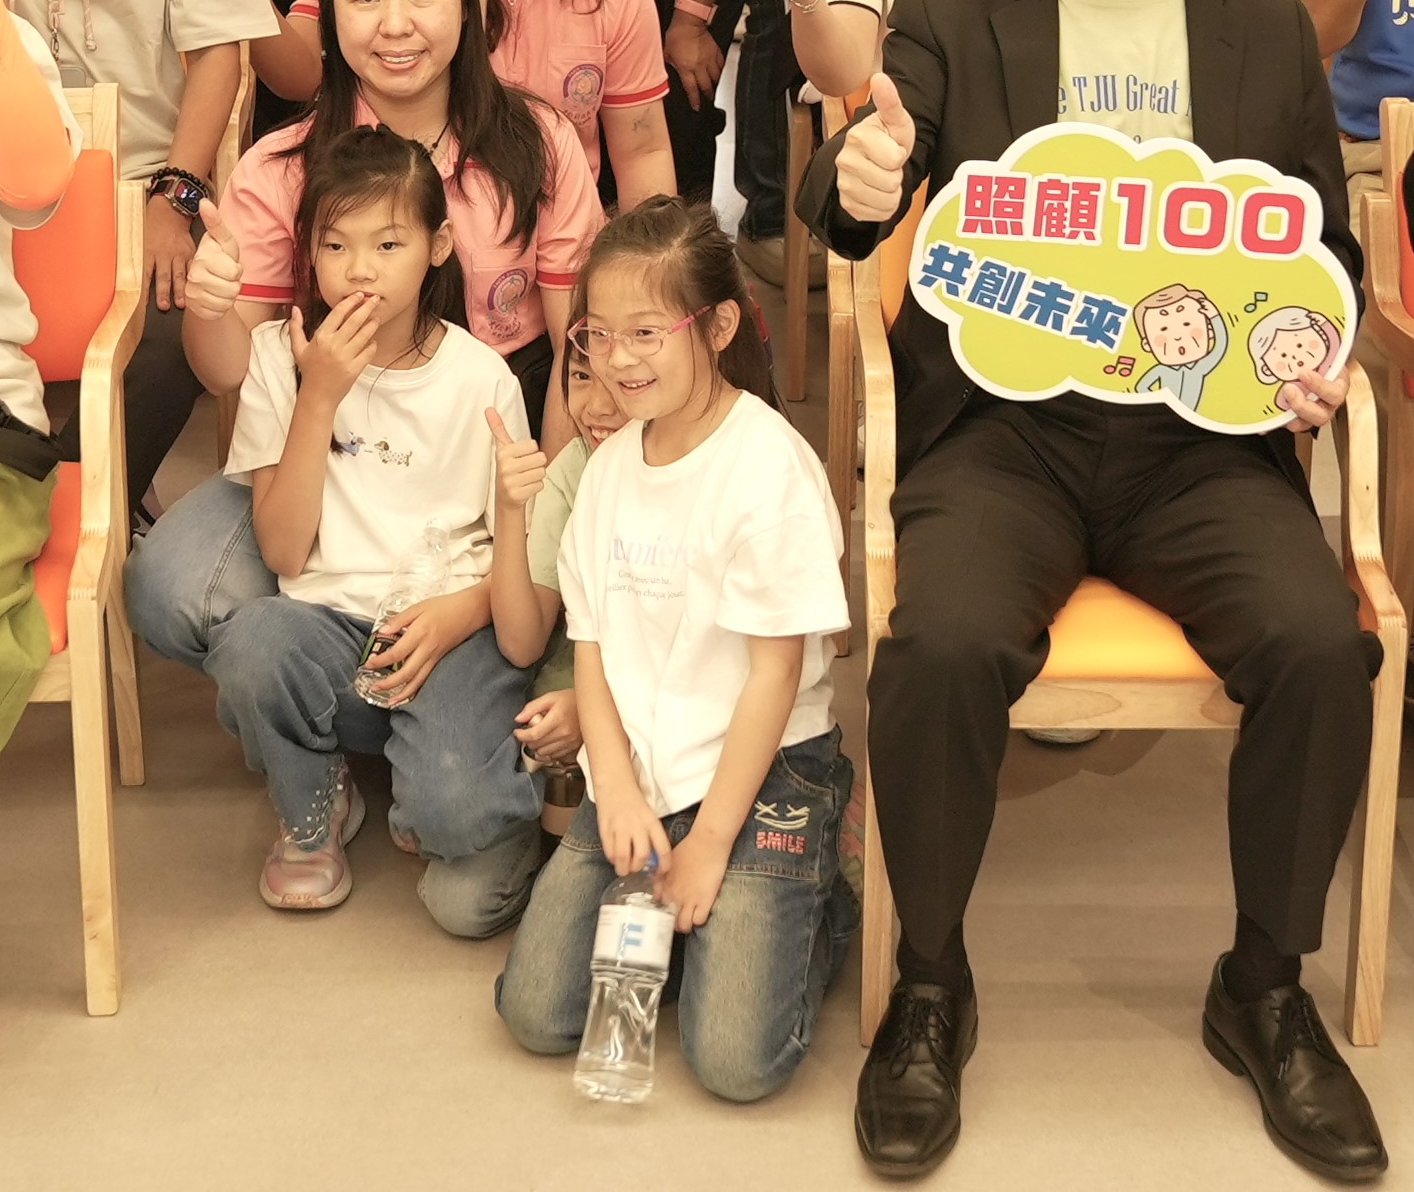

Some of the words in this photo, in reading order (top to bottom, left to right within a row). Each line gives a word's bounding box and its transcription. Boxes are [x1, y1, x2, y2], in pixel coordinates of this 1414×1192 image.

[1072, 74, 1118, 113] TJU
[1126, 74, 1180, 114] Great
[961, 174, 1306, 255] 照顧100
[920, 243, 1128, 349] 共創未來
[756, 831, 806, 855] SMILE
